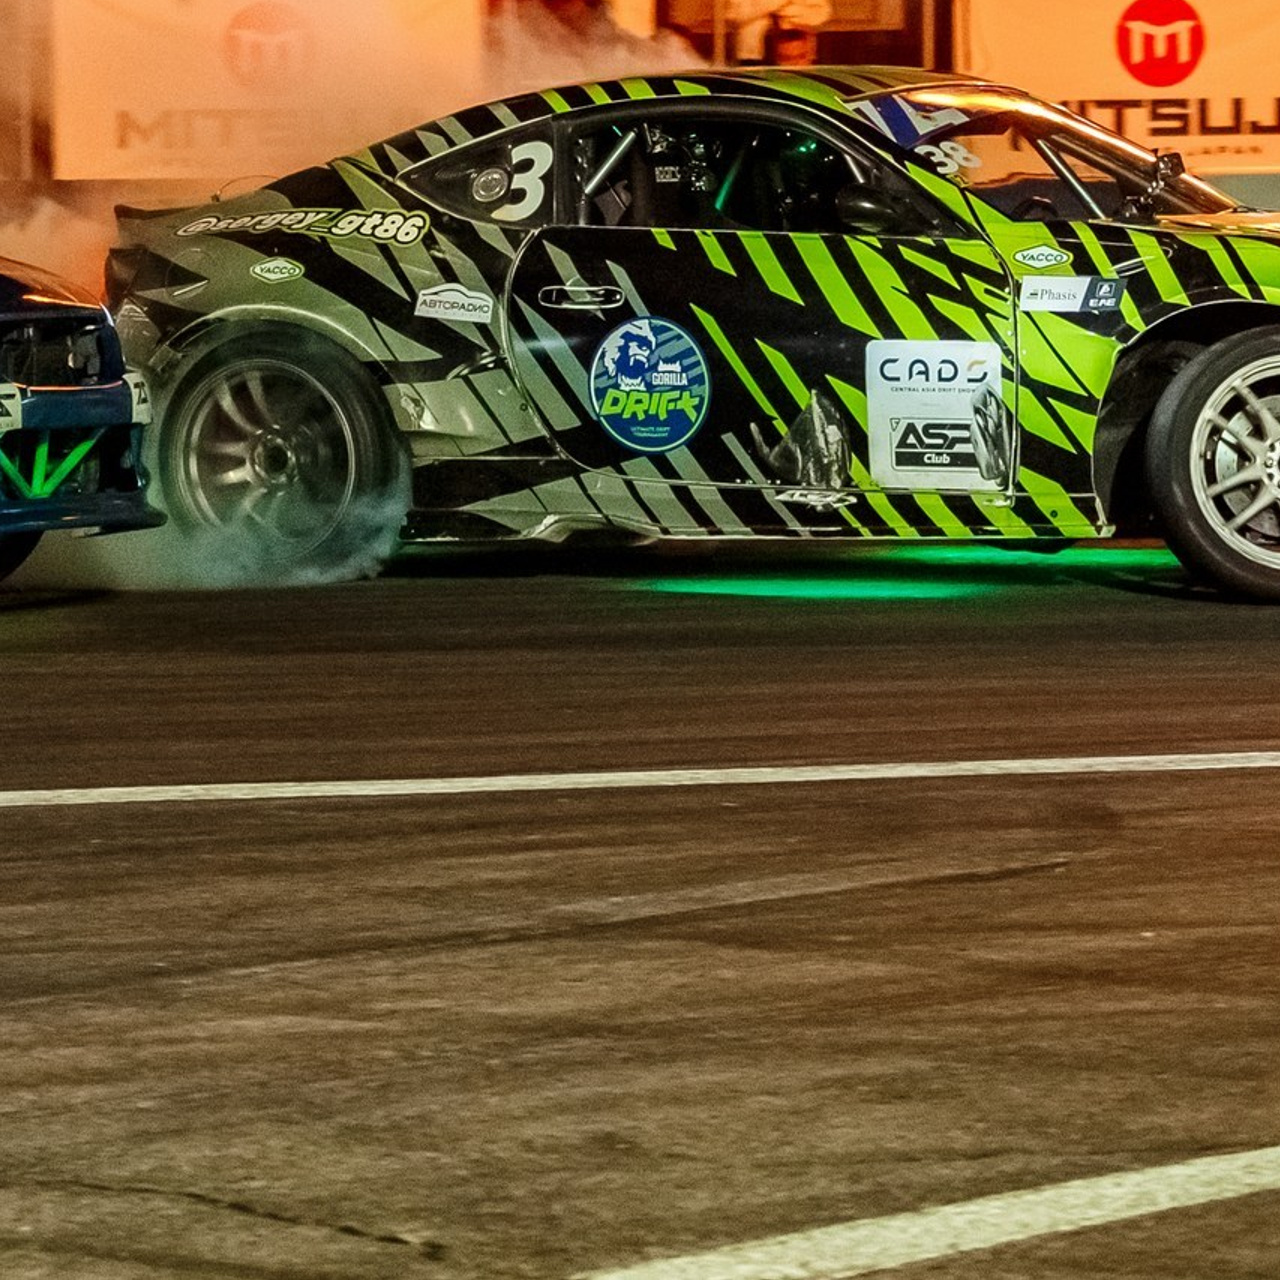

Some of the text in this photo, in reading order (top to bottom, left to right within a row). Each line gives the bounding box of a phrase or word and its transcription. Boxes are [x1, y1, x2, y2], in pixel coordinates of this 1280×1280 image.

[914, 141, 982, 174] 38
[491, 141, 554, 221] 3
[176, 208, 425, 244] @sergey_gt86
[1020, 252, 1065, 262] YACCO
[258, 265, 297, 275] YACCO
[1040, 288, 1077, 300] Phasis
[652, 372, 688, 386] GORILLA
[879, 358, 988, 382] CADS
[600, 388, 700, 422] DRIFT
[923, 453, 951, 464] Club
